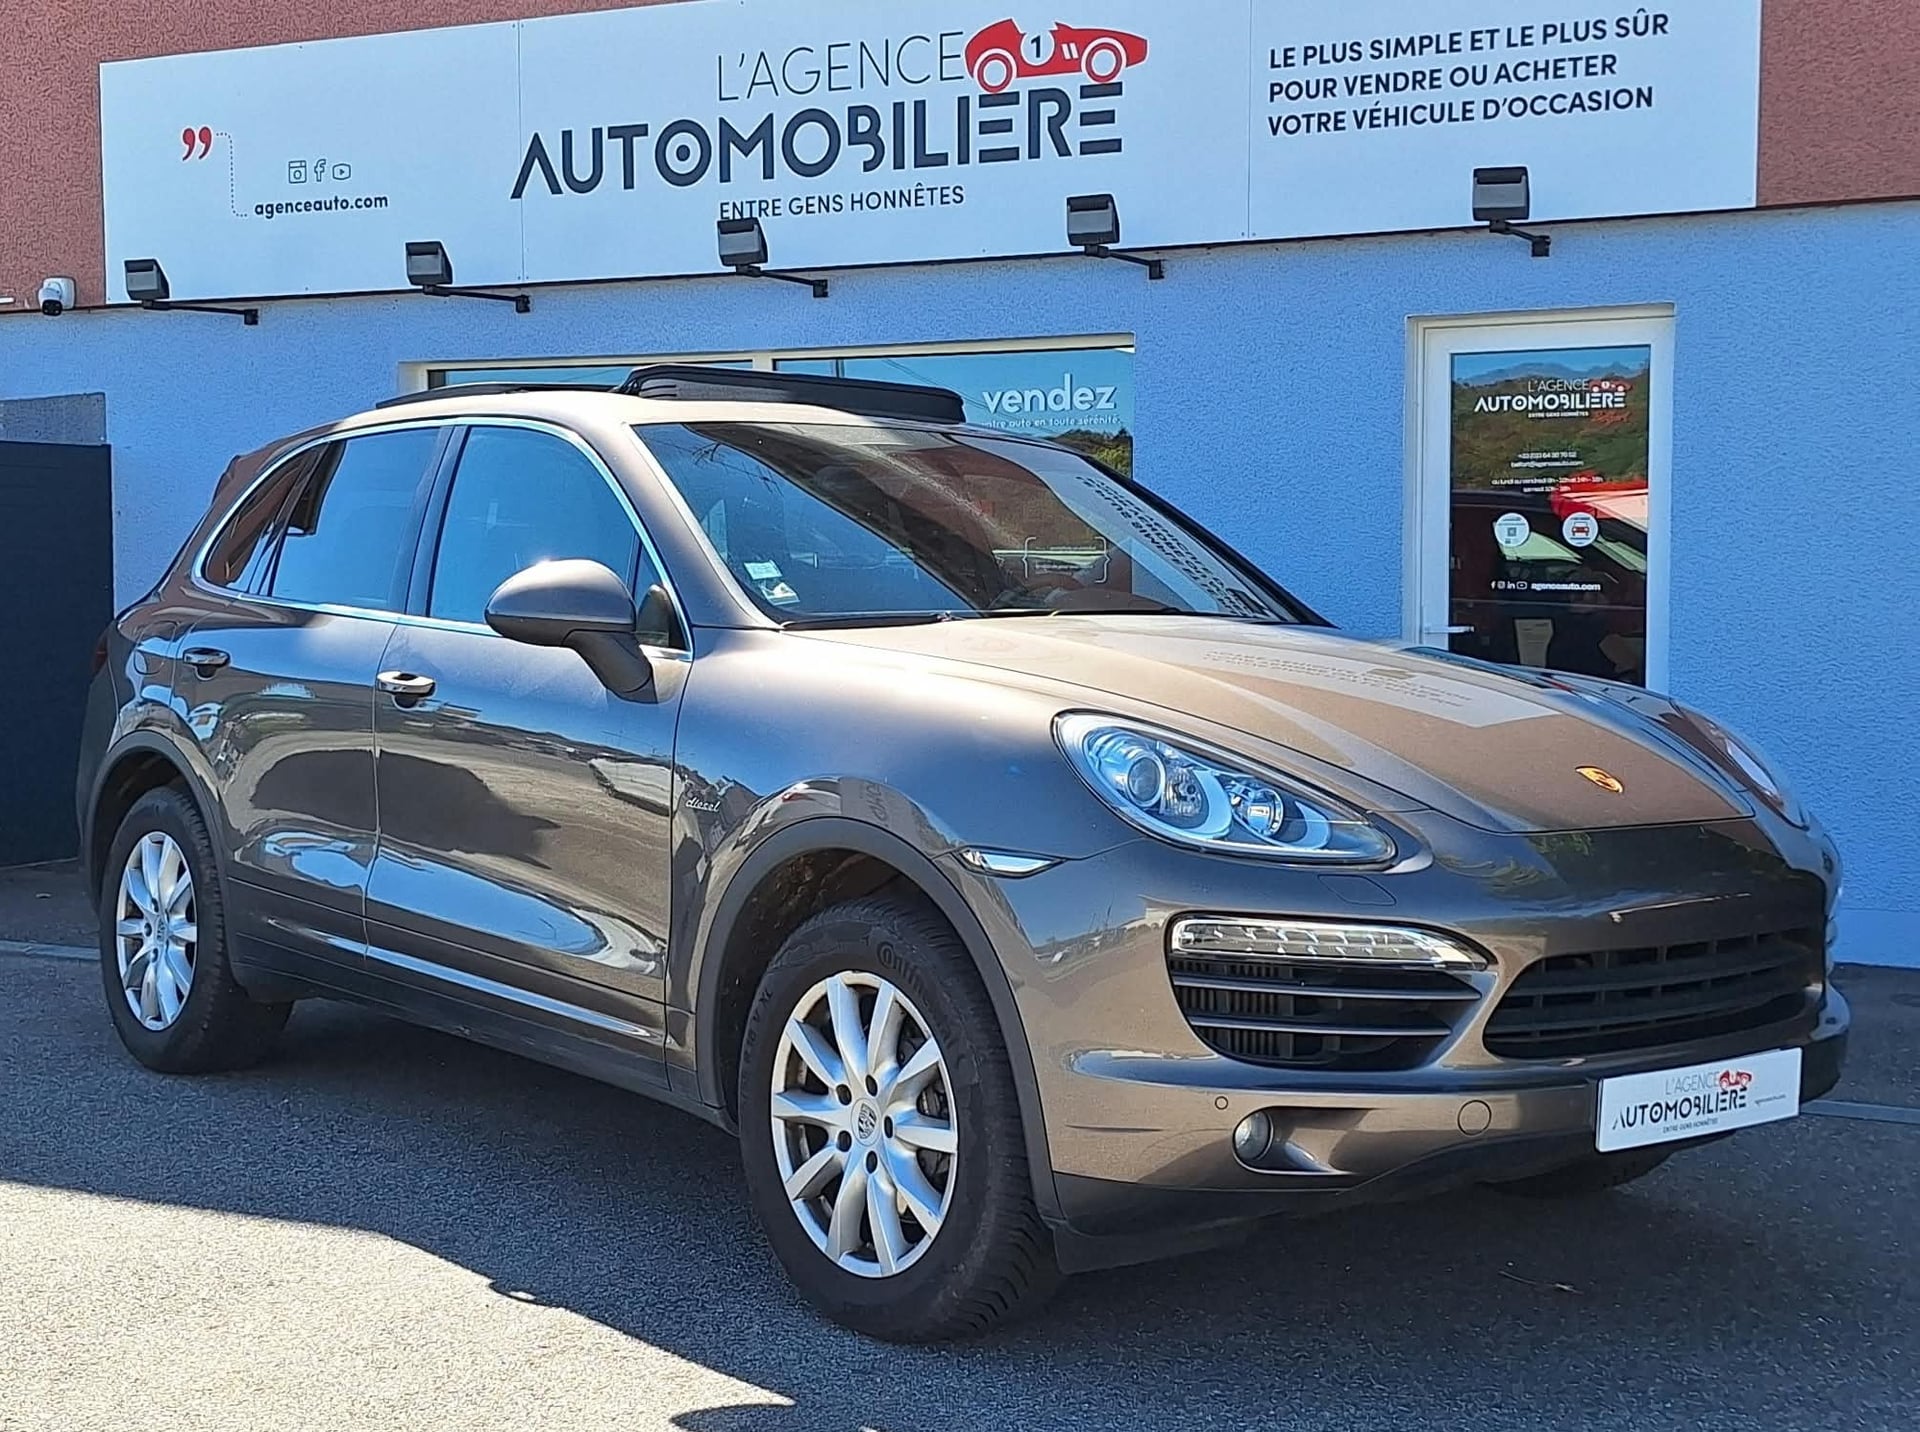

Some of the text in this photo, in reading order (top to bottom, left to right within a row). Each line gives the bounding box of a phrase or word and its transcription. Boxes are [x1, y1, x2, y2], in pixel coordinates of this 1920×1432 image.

[1270, 7, 1669, 69] LE PLUS SIMPLE ET LE PLUS SÛR
[718, 31, 965, 102] L'AGENCE
[1269, 54, 1617, 103] POUR VENDRE OU ACHETER
[1268, 86, 1653, 137] VOTRE VÉHICULE D'OCCASION
[254, 195, 388, 220] agenceauto.com
[719, 183, 964, 220] ENTRE GENS HONNÊTES
[982, 373, 1117, 413] vendez
